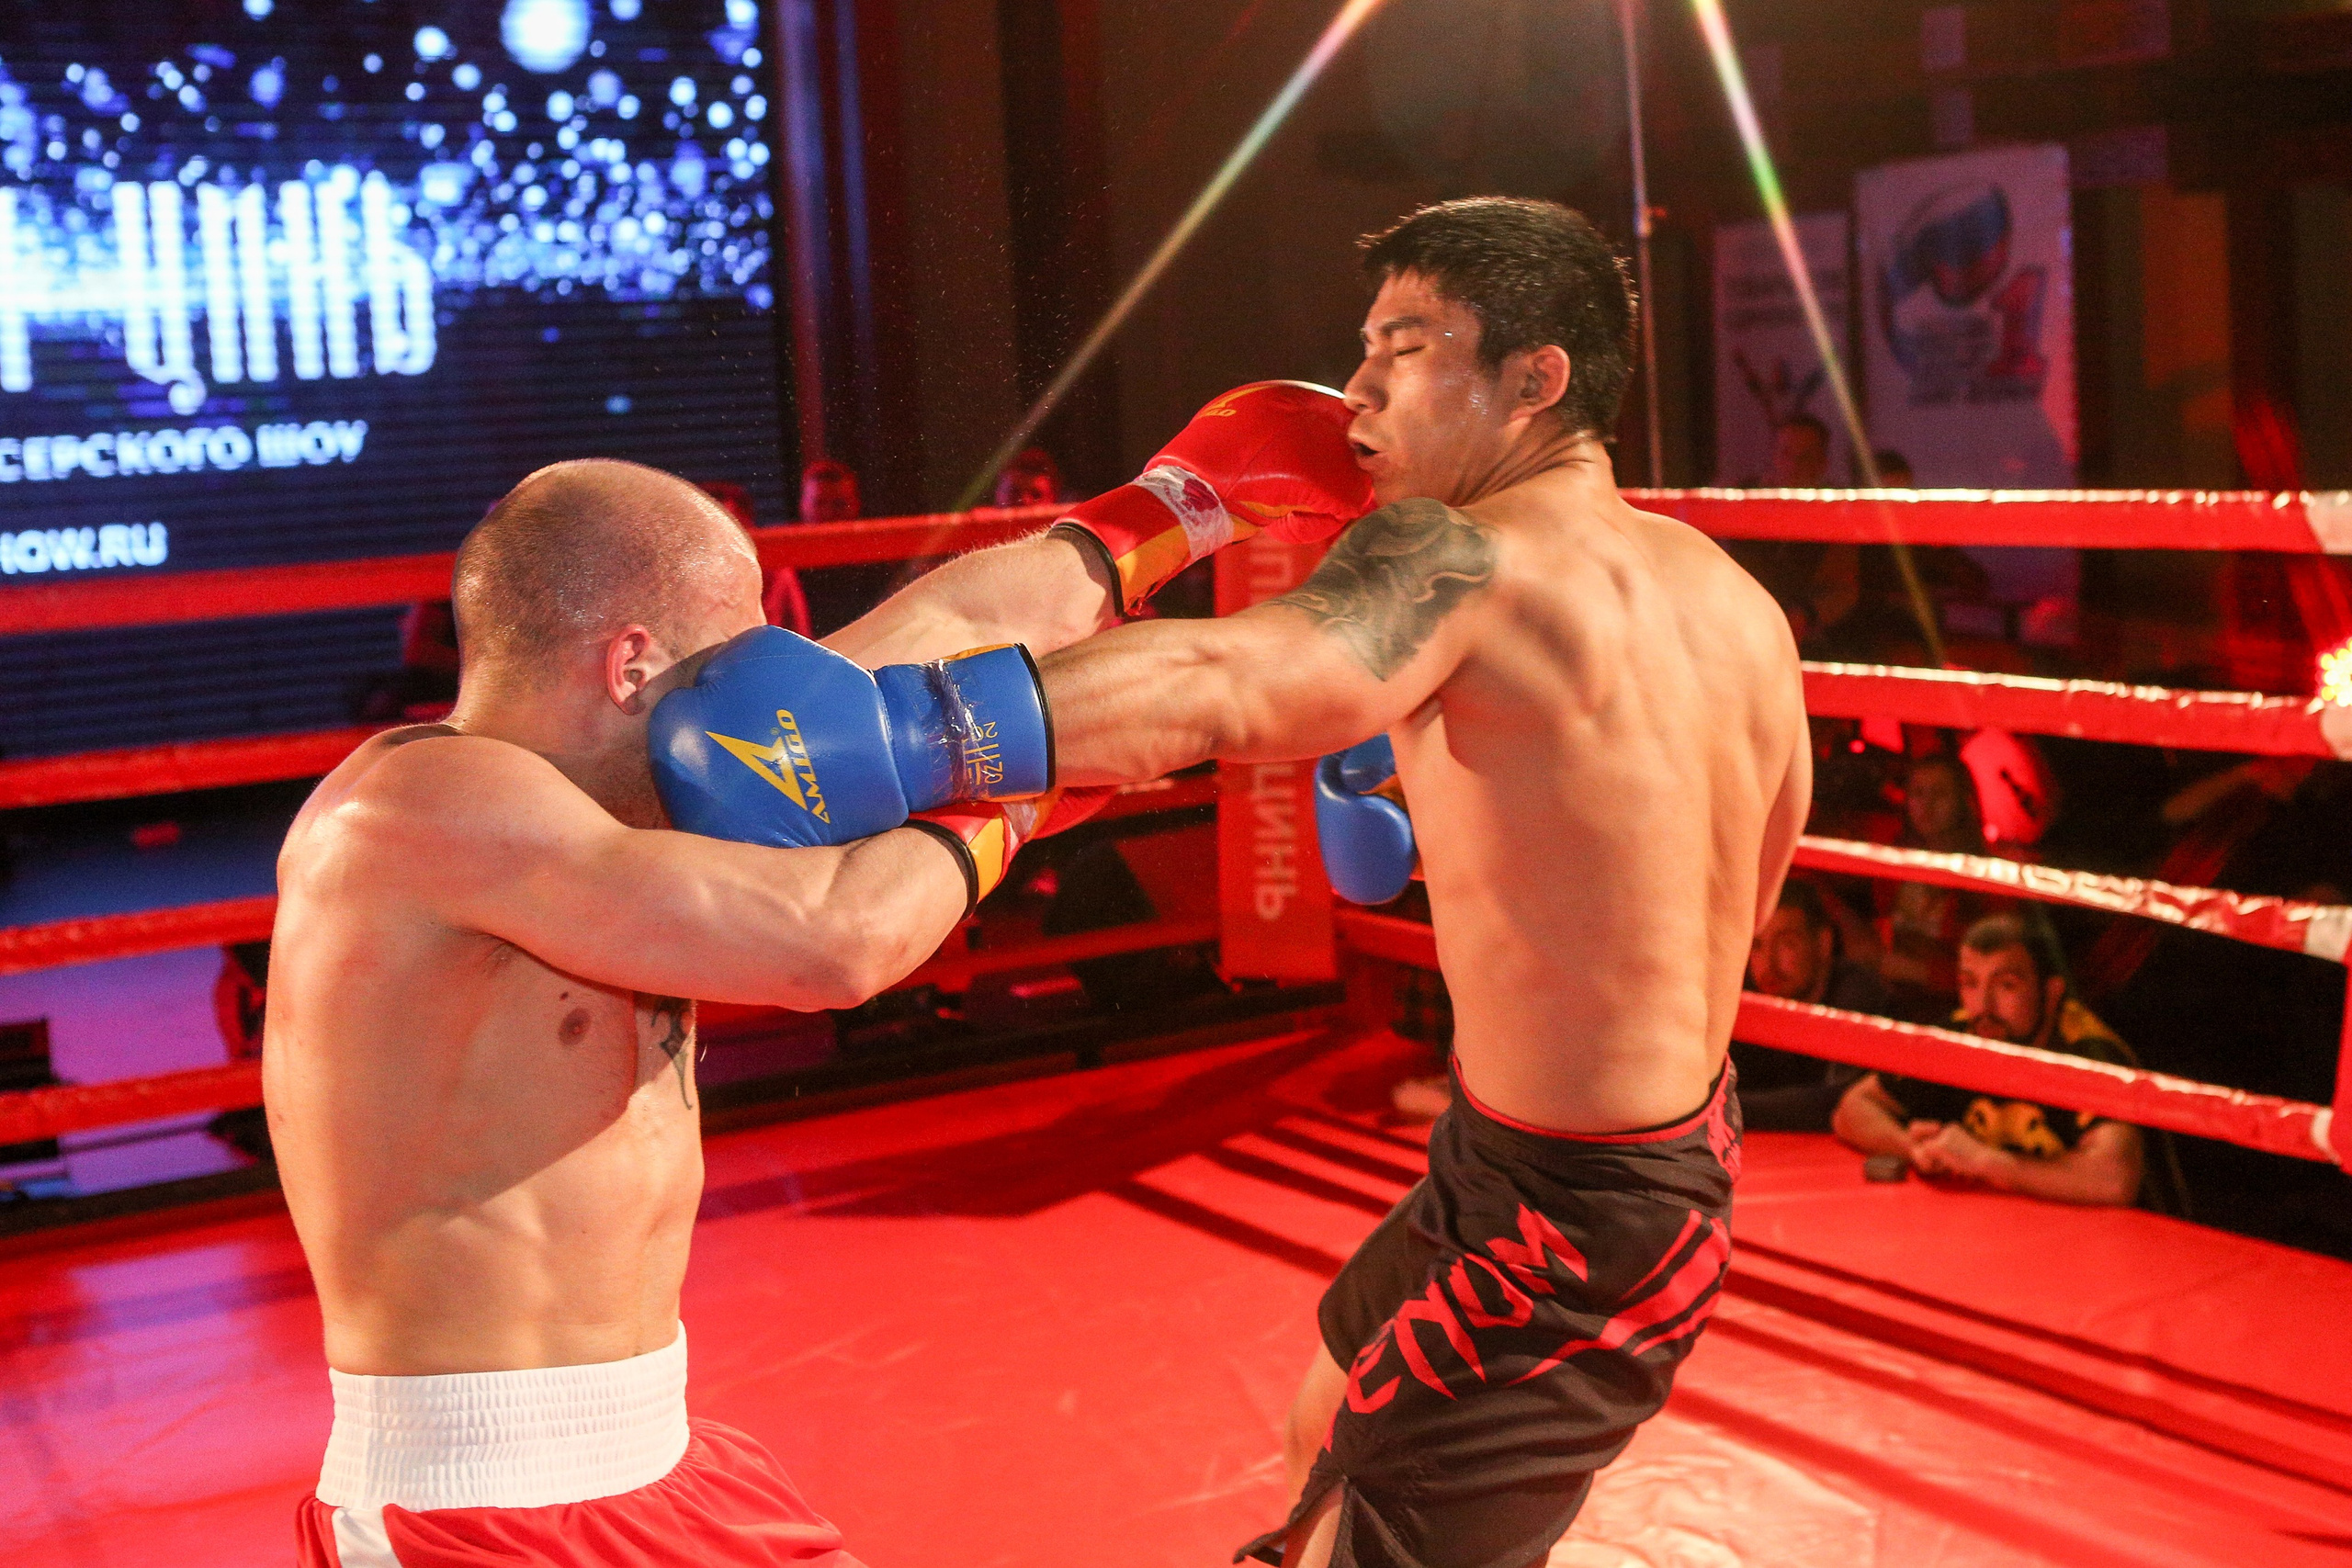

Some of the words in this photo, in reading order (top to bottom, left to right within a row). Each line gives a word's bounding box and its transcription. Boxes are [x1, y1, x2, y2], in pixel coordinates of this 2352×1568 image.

[256, 419, 368, 468] ШОУ
[775, 708, 831, 825] AMIGO
[1250, 764, 1299, 920] ЦИНЬ
